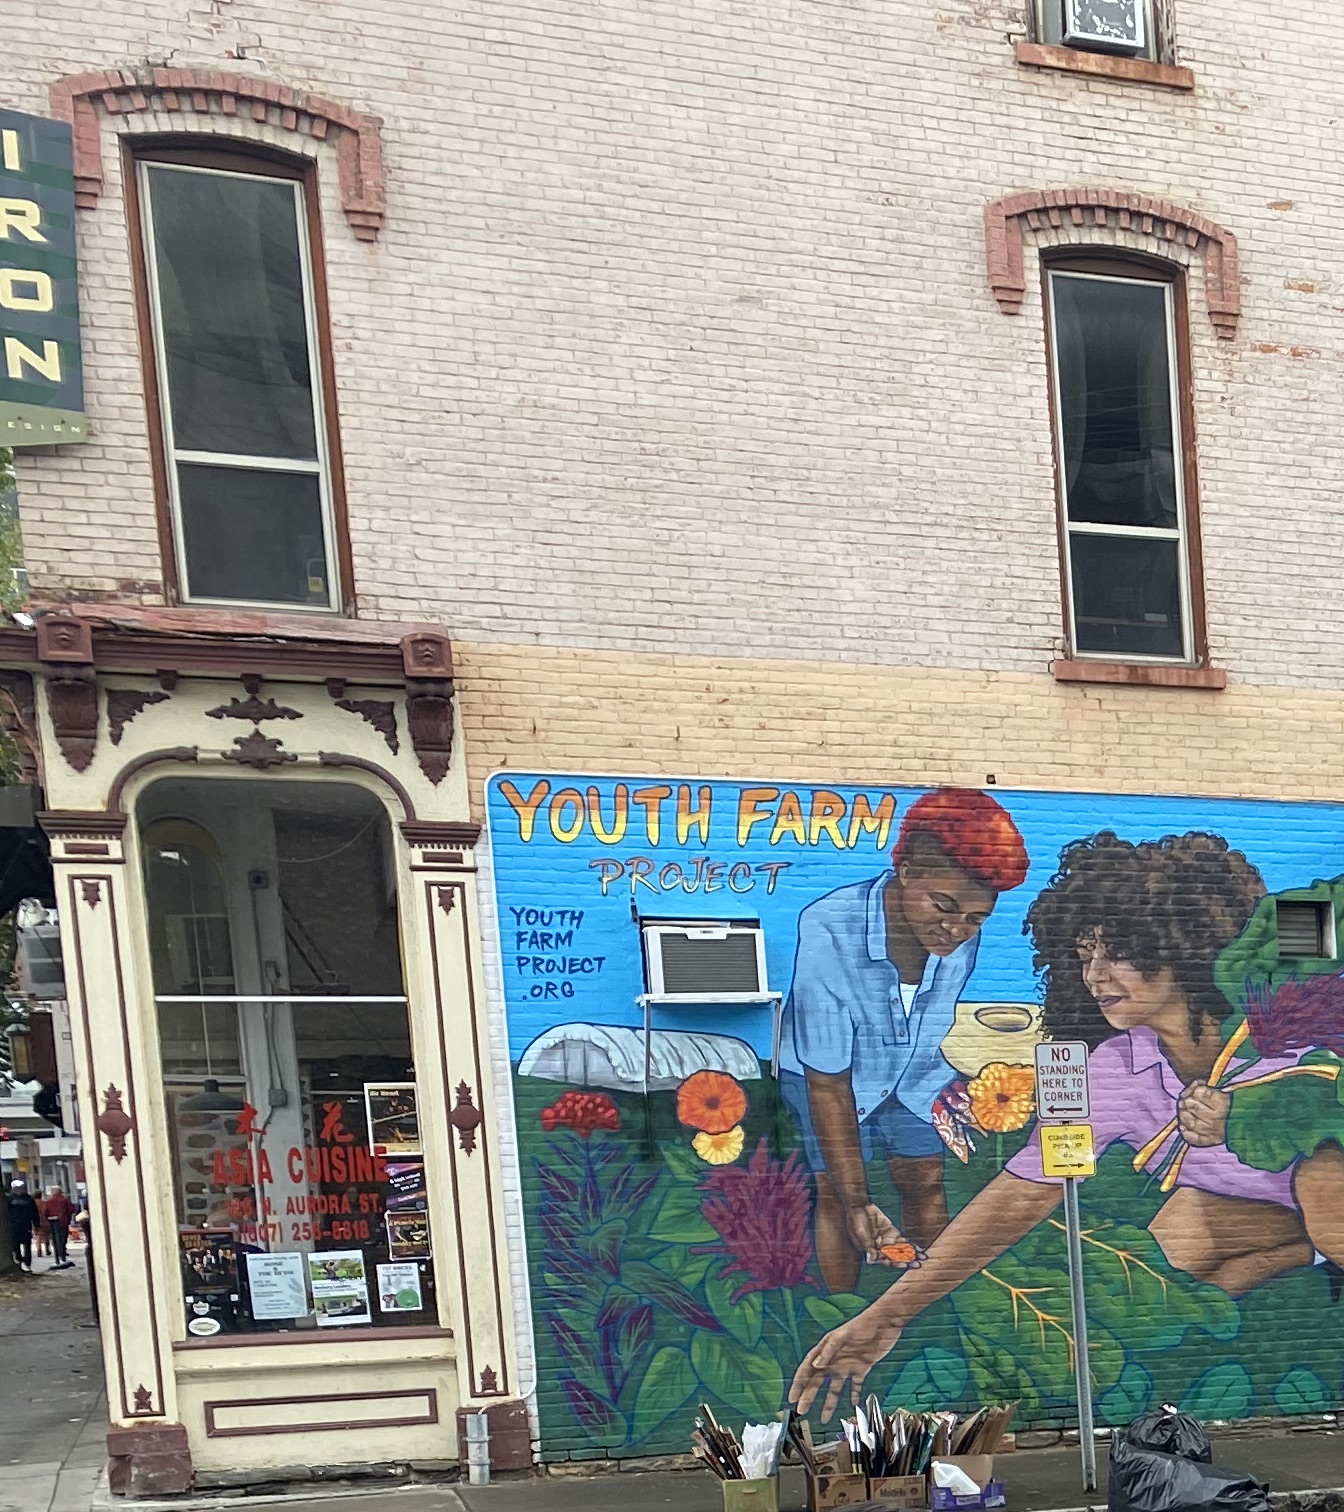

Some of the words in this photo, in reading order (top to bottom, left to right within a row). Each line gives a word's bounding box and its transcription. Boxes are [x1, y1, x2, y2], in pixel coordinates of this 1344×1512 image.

[0, 128, 61, 382] IRON
[497, 779, 712, 847] YOUTH
[738, 788, 898, 851] FARM
[589, 856, 794, 896] PROJECT
[509, 906, 584, 930] YOUTH
[515, 930, 573, 951] FARM
[516, 956, 606, 975] PROJECT
[522, 981, 575, 1000] .ORG
[1051, 1047, 1071, 1062] NO
[1039, 1064, 1085, 1076] STANDING
[1042, 1078, 1068, 1089] HERE
[1072, 1077, 1083, 1088] TO
[1044, 1092, 1083, 1102] CORNER
[212, 1148, 273, 1185] ASIA
[287, 1145, 389, 1184] CUISINE
[261, 1196, 277, 1217] N.
[286, 1193, 352, 1216] AURORA
[360, 1192, 384, 1214] ST.
